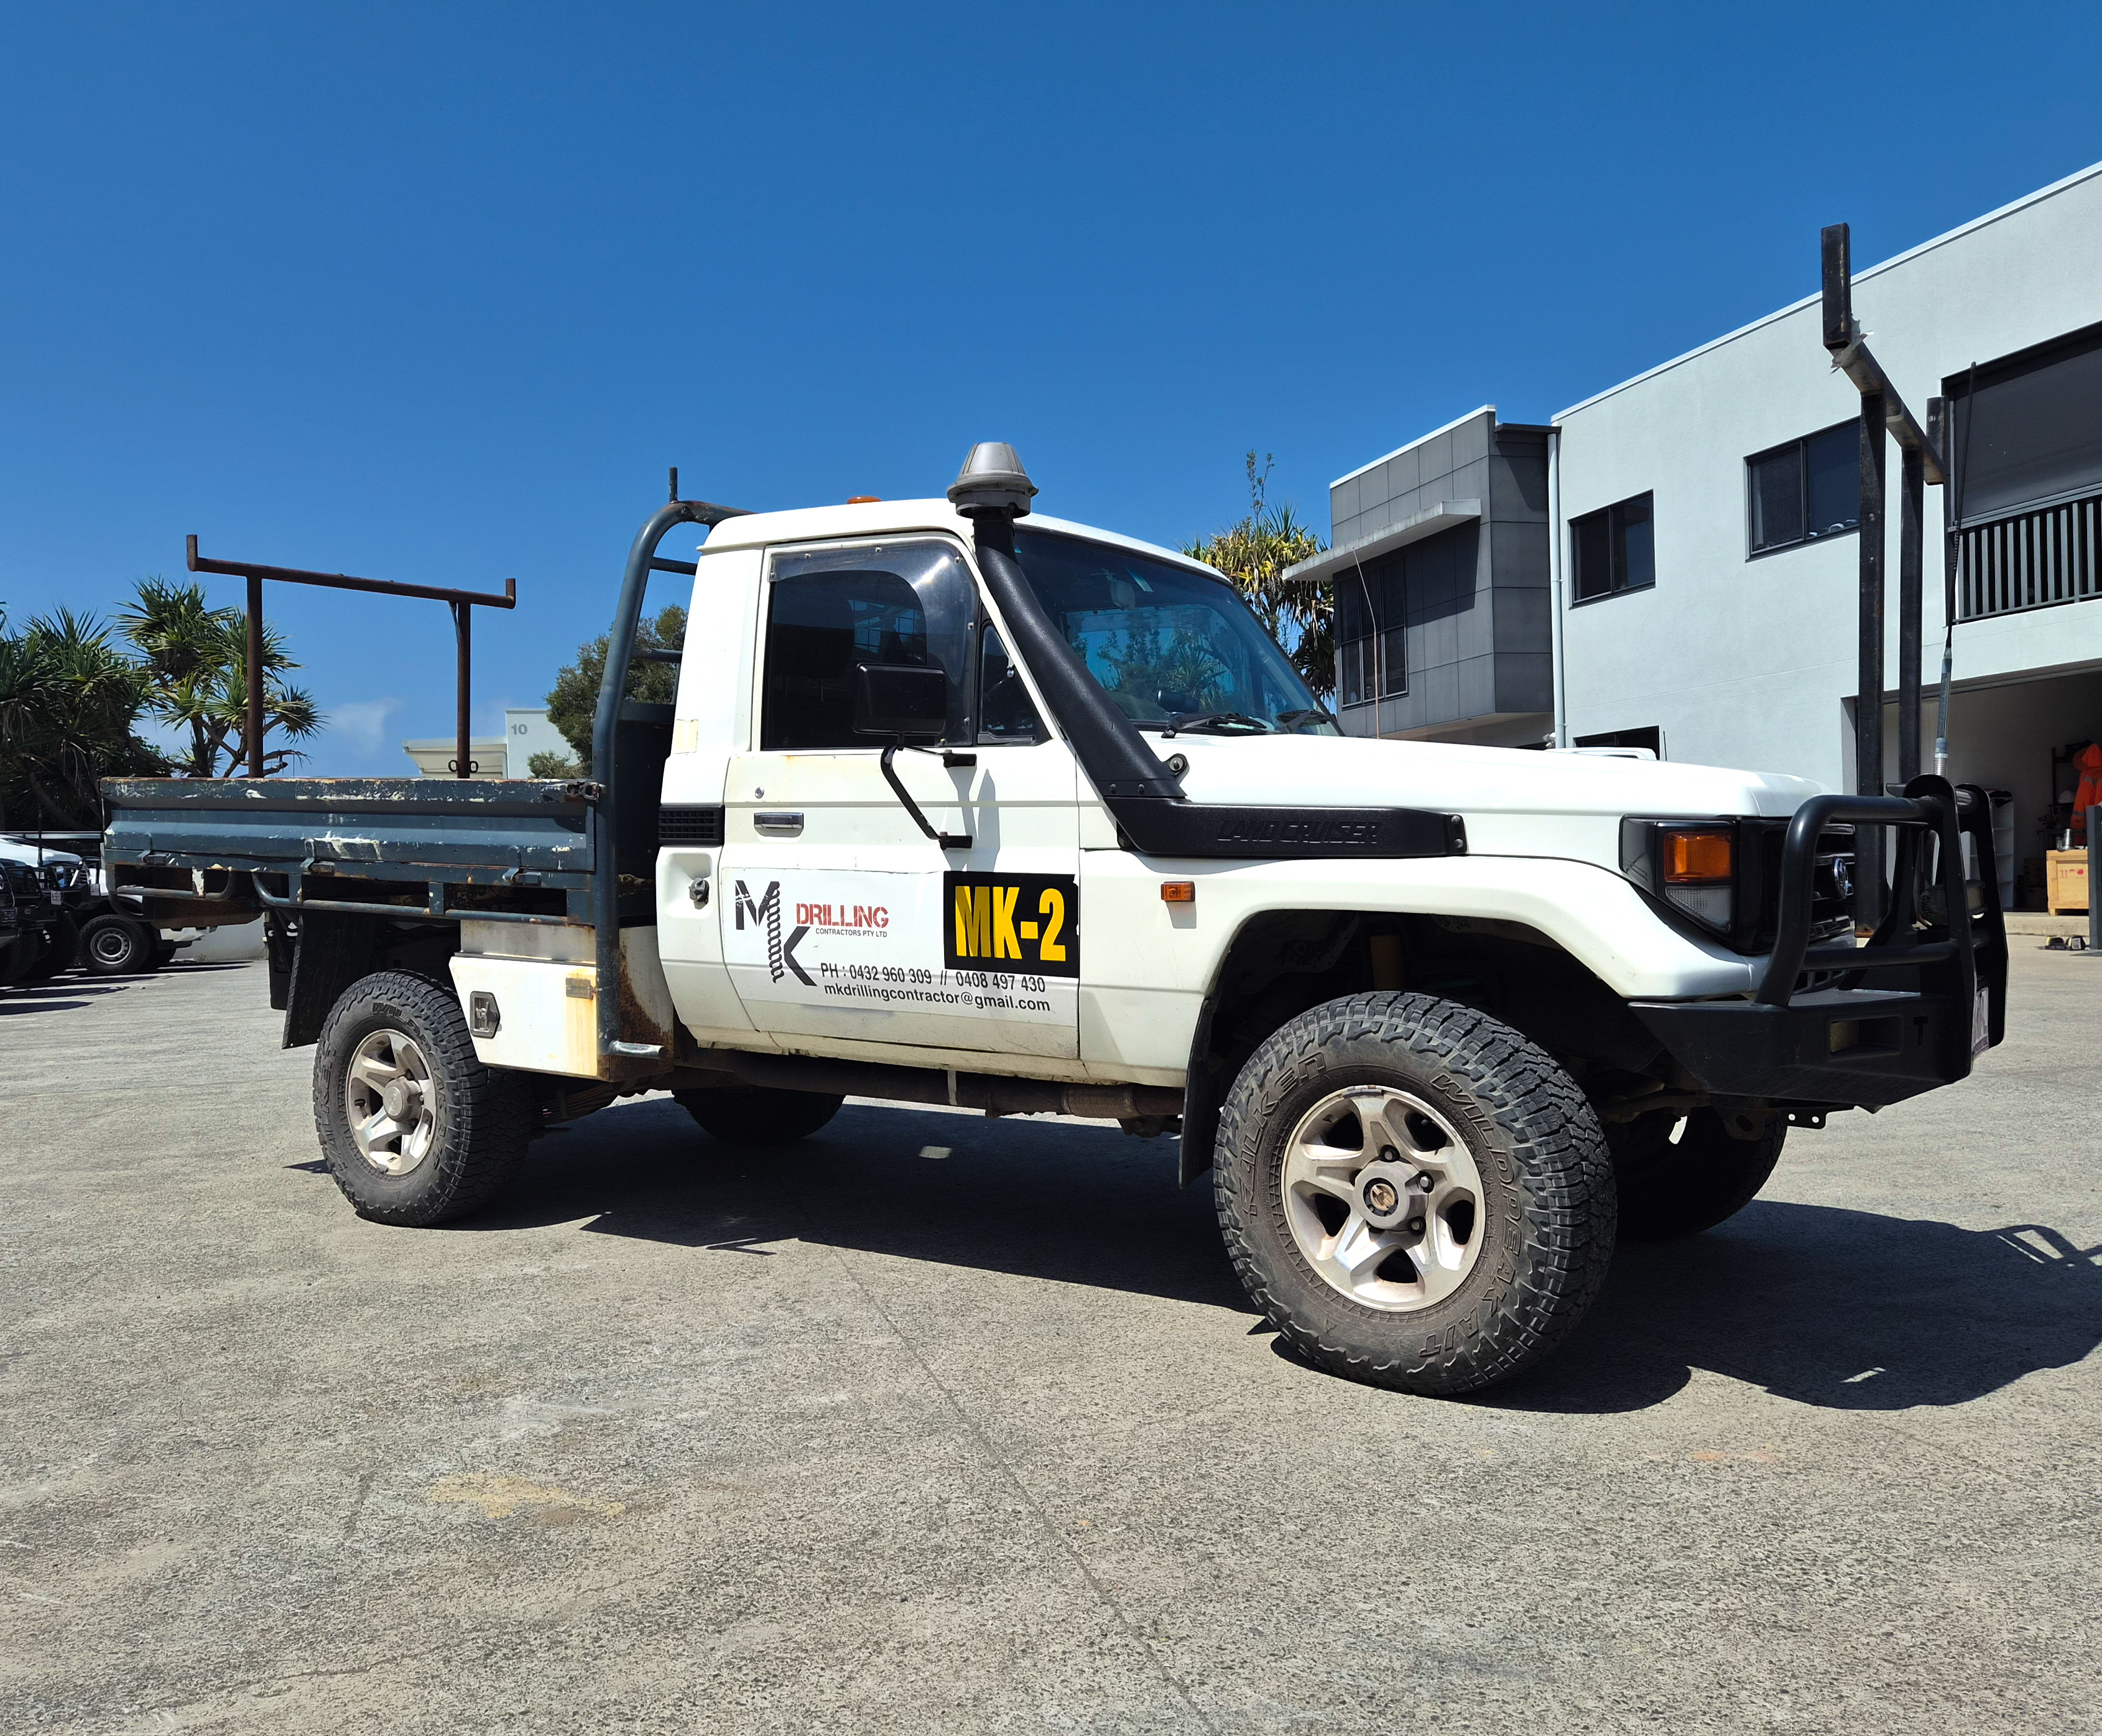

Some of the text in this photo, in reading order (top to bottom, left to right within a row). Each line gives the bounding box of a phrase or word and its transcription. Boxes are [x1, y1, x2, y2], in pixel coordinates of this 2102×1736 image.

[511, 723, 527, 735] 10
[1279, 821, 1380, 844] CRUISER
[796, 903, 889, 929] DRILLING
[955, 885, 1066, 962] MK-2
[815, 927, 861, 937] CONTRACTORS
[820, 962, 839, 978] PH
[849, 964, 880, 981] 0432
[882, 967, 905, 983] 960
[908, 968, 932, 985] 309
[955, 971, 988, 988] 0408
[992, 973, 1016, 990] 497
[1021, 976, 1045, 993] 430
[824, 983, 1050, 1011] mkdrillingcontractor@gmail.com
[1429, 1073, 1522, 1317] WILDPEAK
